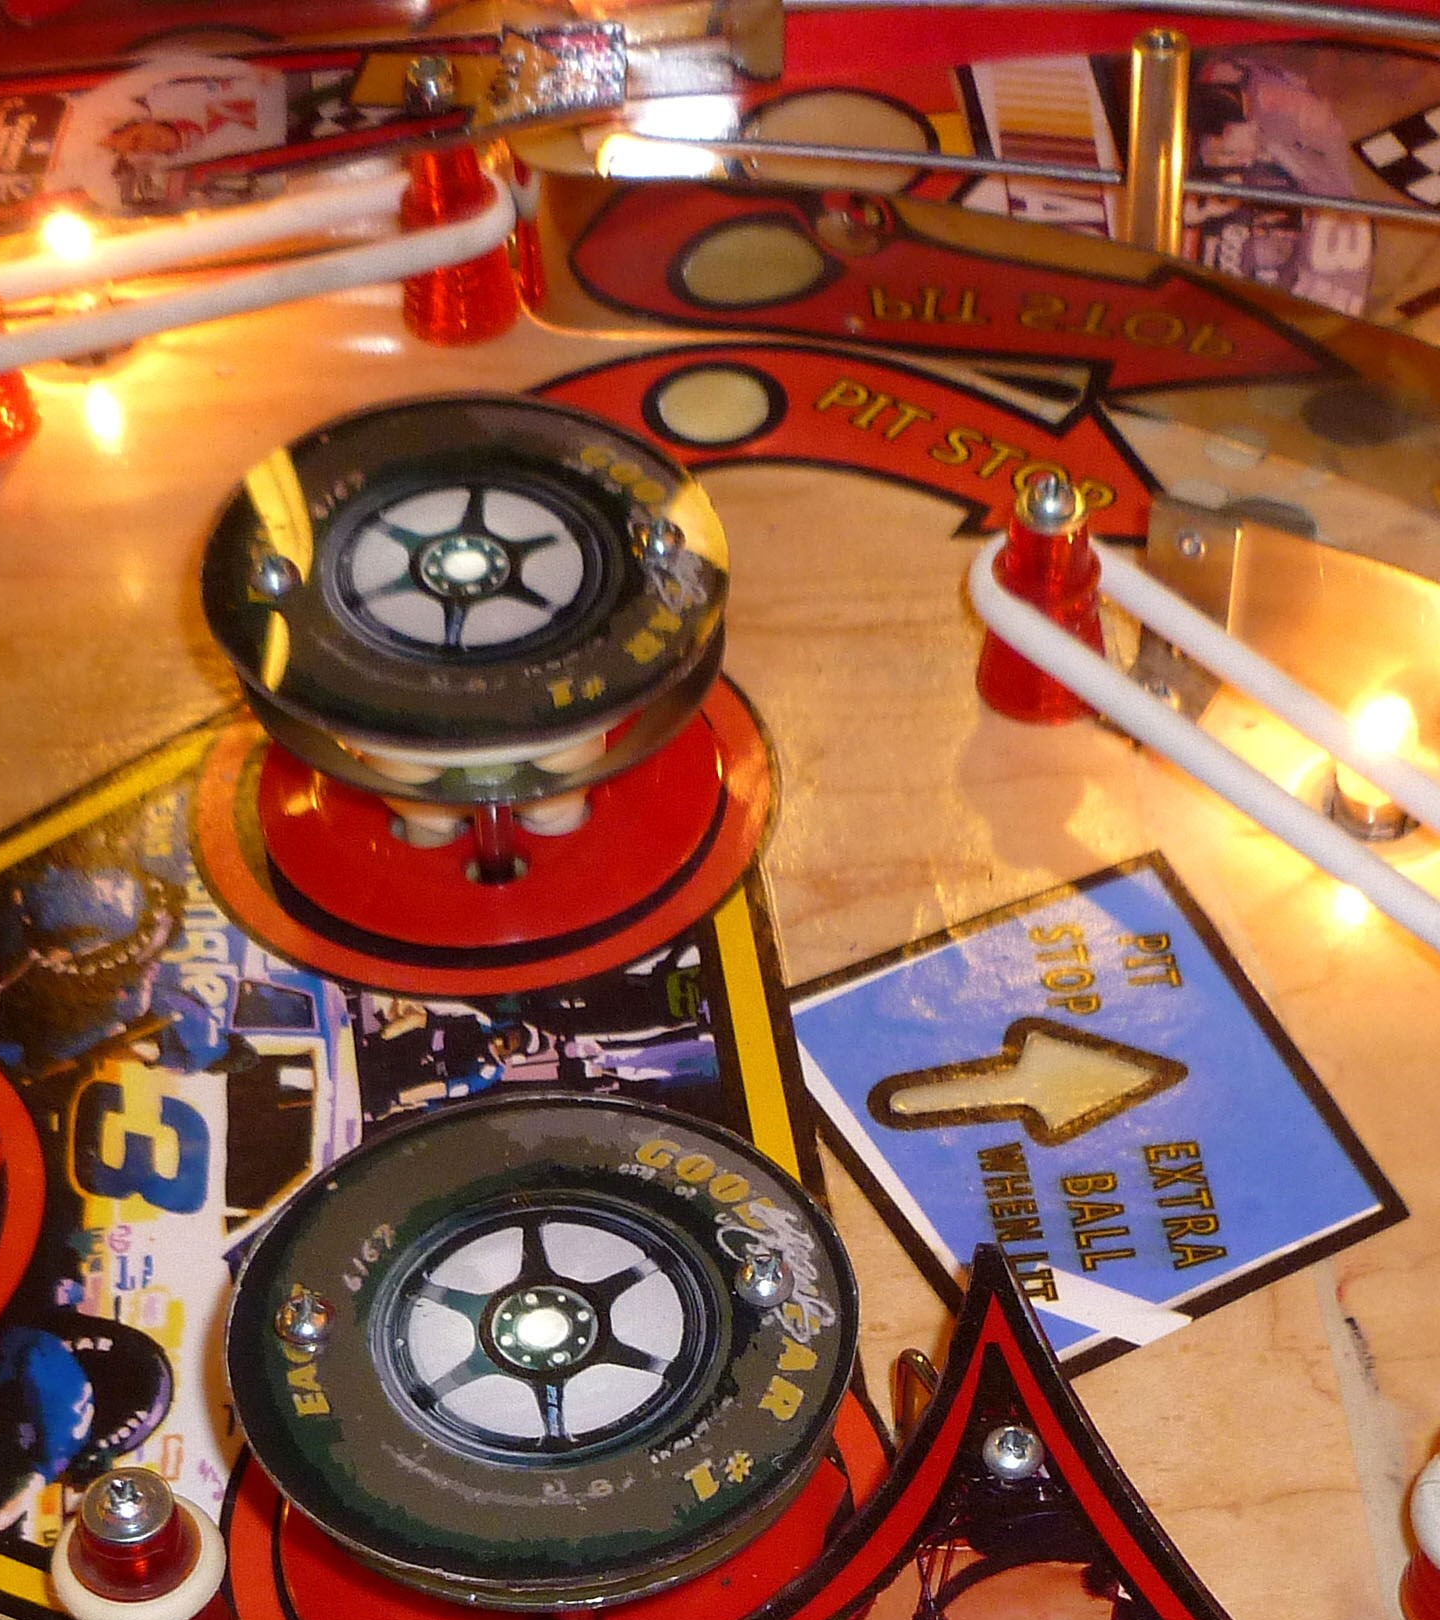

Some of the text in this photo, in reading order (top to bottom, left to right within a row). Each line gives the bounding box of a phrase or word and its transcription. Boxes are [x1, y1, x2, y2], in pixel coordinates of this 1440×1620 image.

[813, 377, 933, 441] PIT
[1028, 921, 1102, 1016] STOP
[1117, 933, 1183, 989] PIT
[70, 1079, 210, 1216] 3
[976, 1141, 1059, 1302] WHEN LIT
[1062, 1171, 1137, 1272] BALL
[1143, 1141, 1228, 1271] EXTRA
